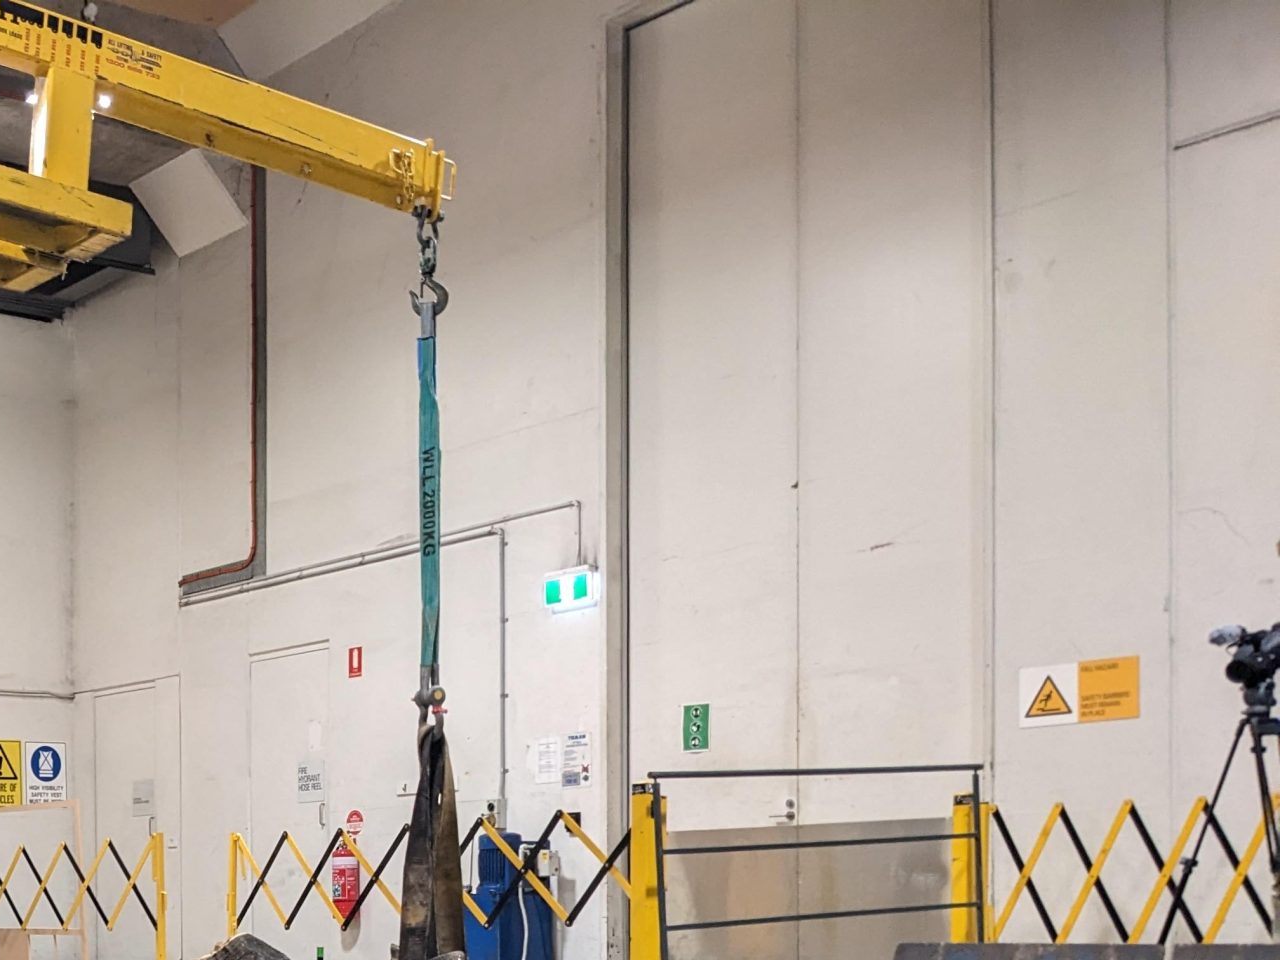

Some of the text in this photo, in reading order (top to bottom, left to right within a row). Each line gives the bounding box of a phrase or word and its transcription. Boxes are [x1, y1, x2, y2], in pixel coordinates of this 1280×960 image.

[422, 446, 436, 558] WLL 2000KG
[9, 783, 18, 792] OF
